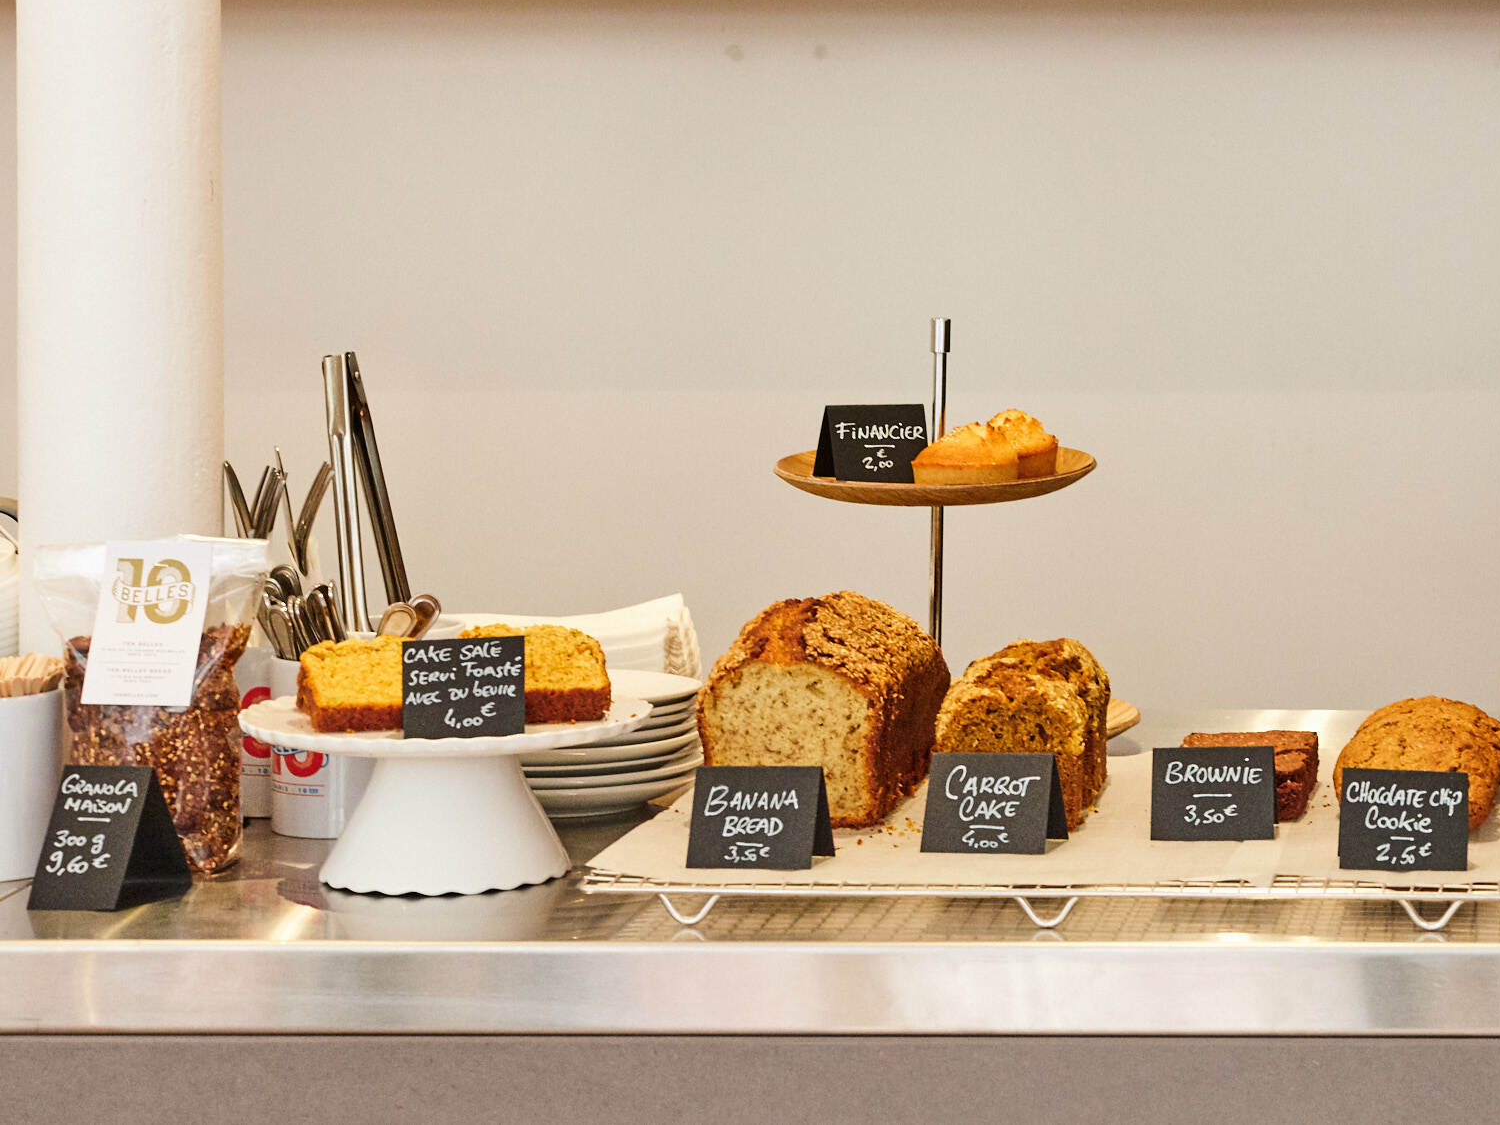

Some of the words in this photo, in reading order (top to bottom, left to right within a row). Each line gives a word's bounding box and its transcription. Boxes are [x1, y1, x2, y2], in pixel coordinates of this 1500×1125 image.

[116, 558, 191, 624] 10
[121, 584, 190, 604] BELLES
[404, 646, 452, 663] CAKE
[62, 774, 138, 797] GRANOLA
[946, 765, 1041, 800] CARROT
[704, 785, 798, 816] BANANA
[959, 795, 1020, 821] CAKE
[722, 816, 783, 837] BREAD
[1365, 804, 1434, 833] Cookie
[54, 830, 87, 847] 300
